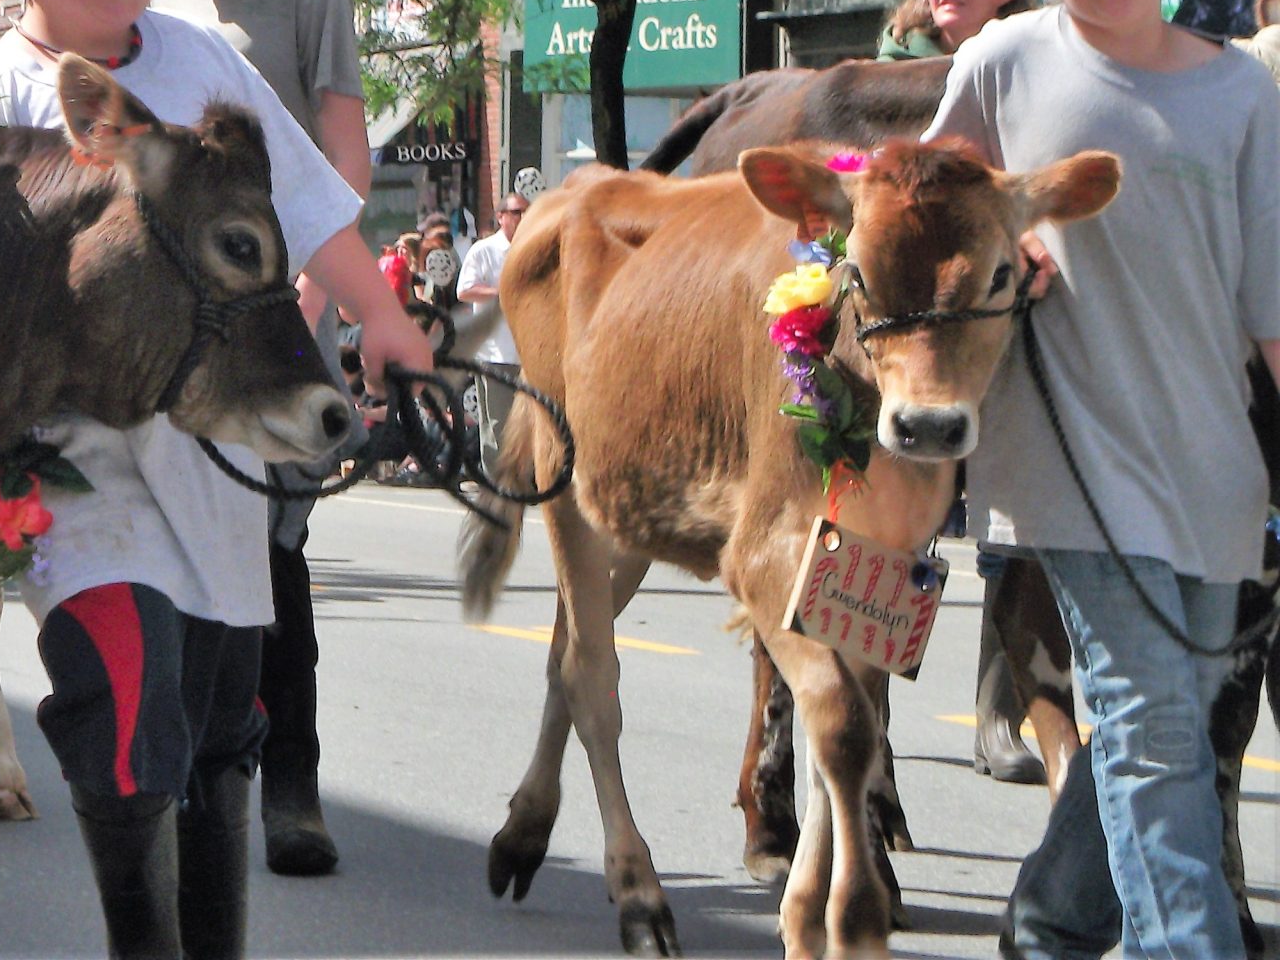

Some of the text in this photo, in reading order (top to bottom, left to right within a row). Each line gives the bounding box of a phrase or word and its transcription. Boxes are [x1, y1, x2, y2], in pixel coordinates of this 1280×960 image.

[638, 13, 718, 52] Crafts
[397, 143, 466, 162] BOOKS
[822, 572, 909, 636] Gwendolyn
